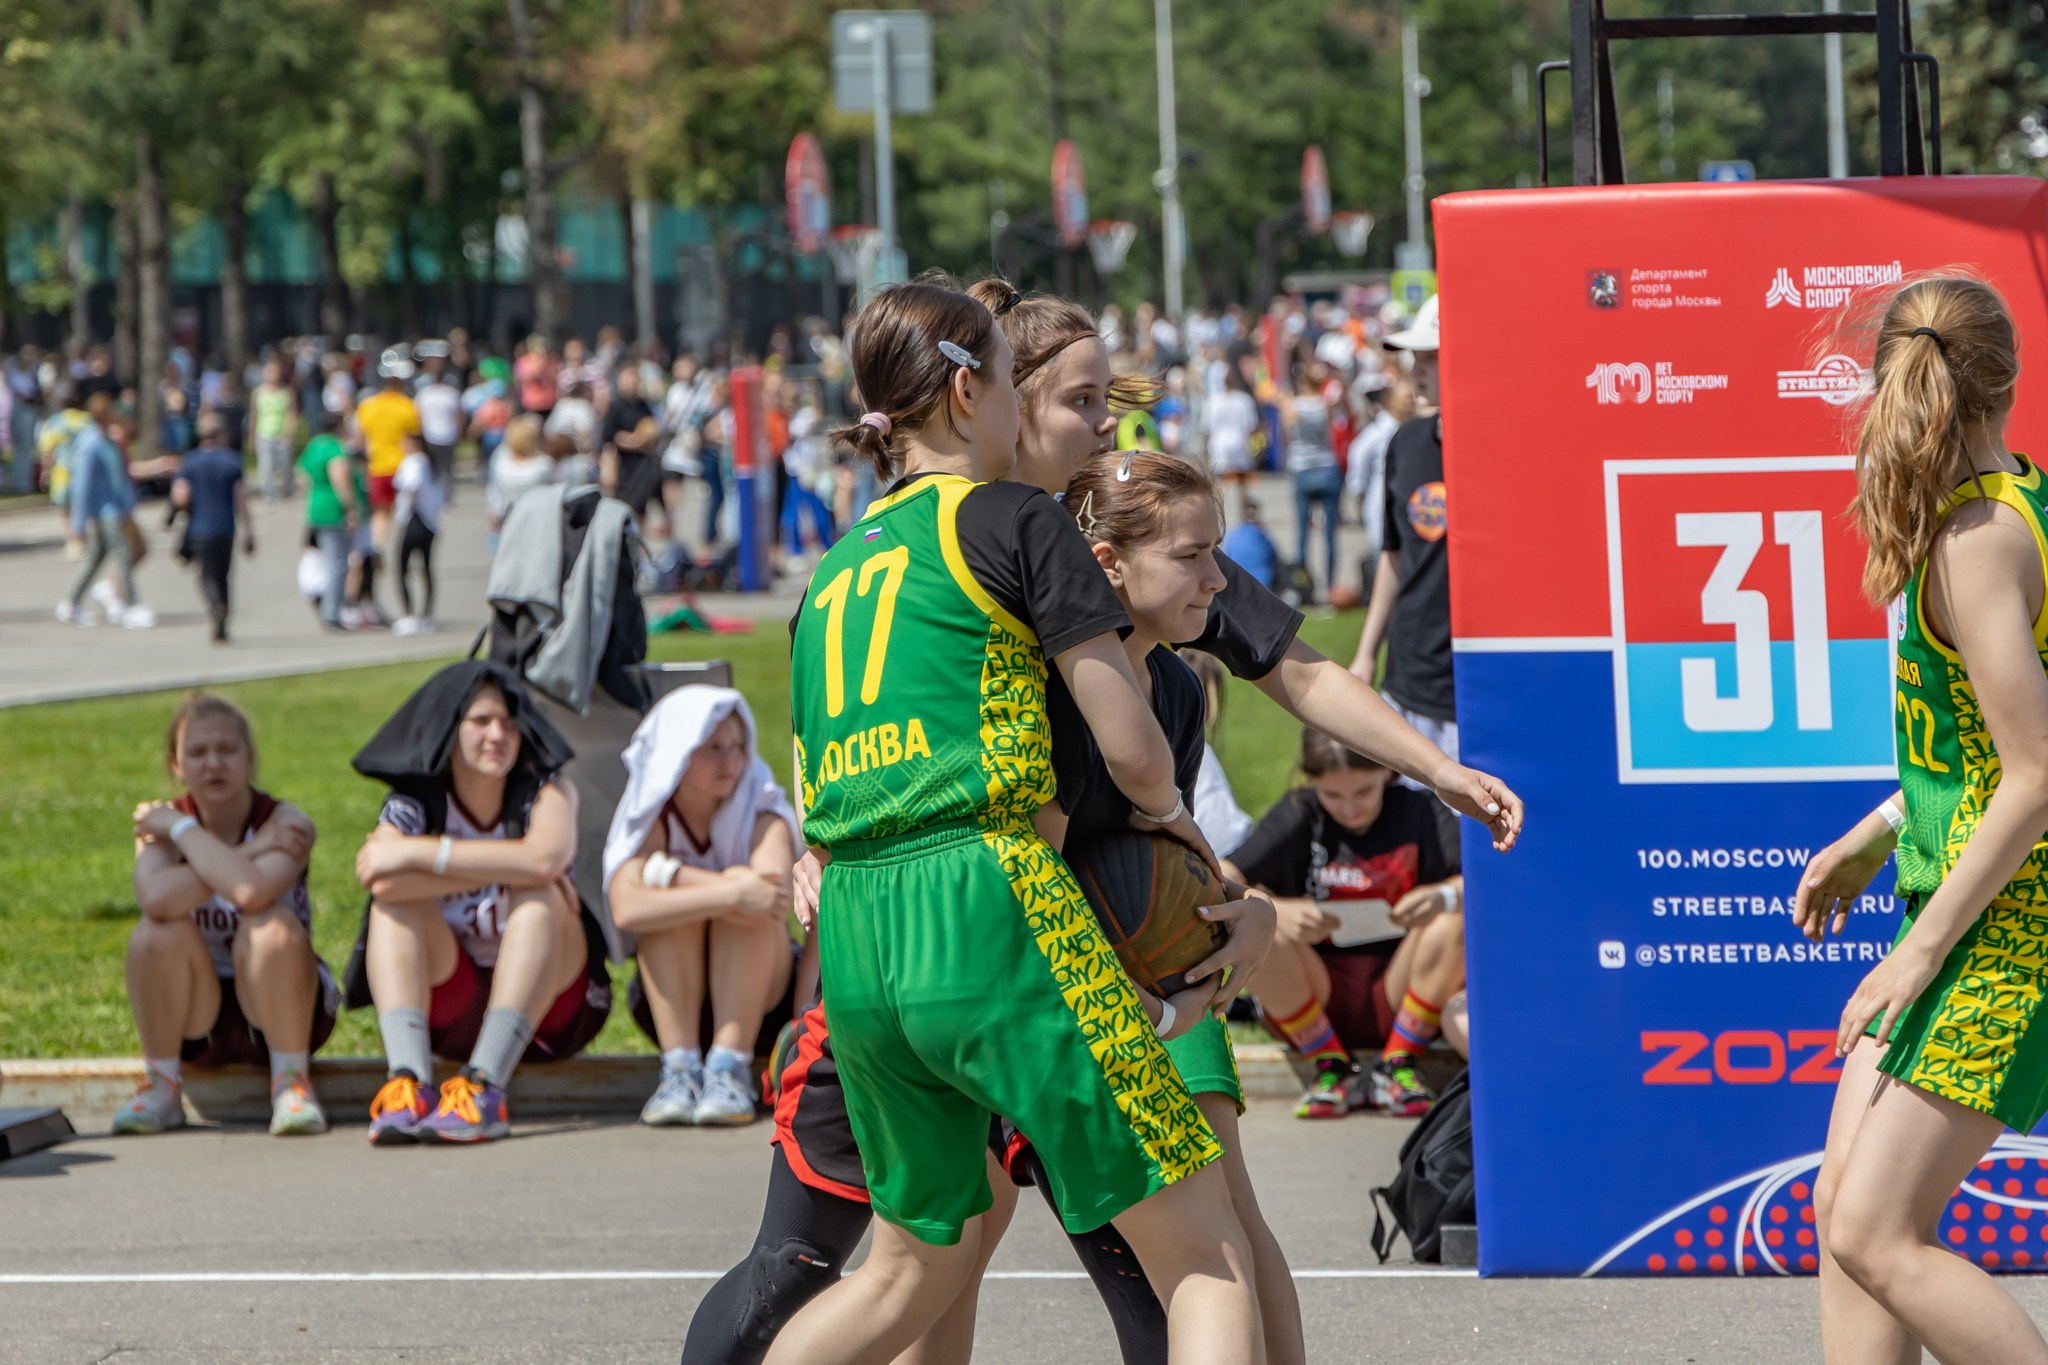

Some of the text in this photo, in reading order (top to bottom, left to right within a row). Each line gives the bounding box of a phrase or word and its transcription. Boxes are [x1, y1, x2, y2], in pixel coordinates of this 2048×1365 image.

[1630, 268, 1708, 281] Департамент
[1803, 260, 1903, 287] МОСКОВСКИЙ
[1631, 283, 1672, 294] спорта
[1632, 295, 1722, 309] города Москвы
[1805, 287, 1852, 309] СПОРТ
[1655, 361, 1673, 375] ЛЕТ
[1655, 374, 1728, 390] МОСКОВСКОМУ
[1656, 389, 1694, 404] СПОРТУ
[1675, 510, 1833, 732] 31
[814, 545, 909, 718] 17
[1653, 895, 1895, 916] STREETBAS.RU
